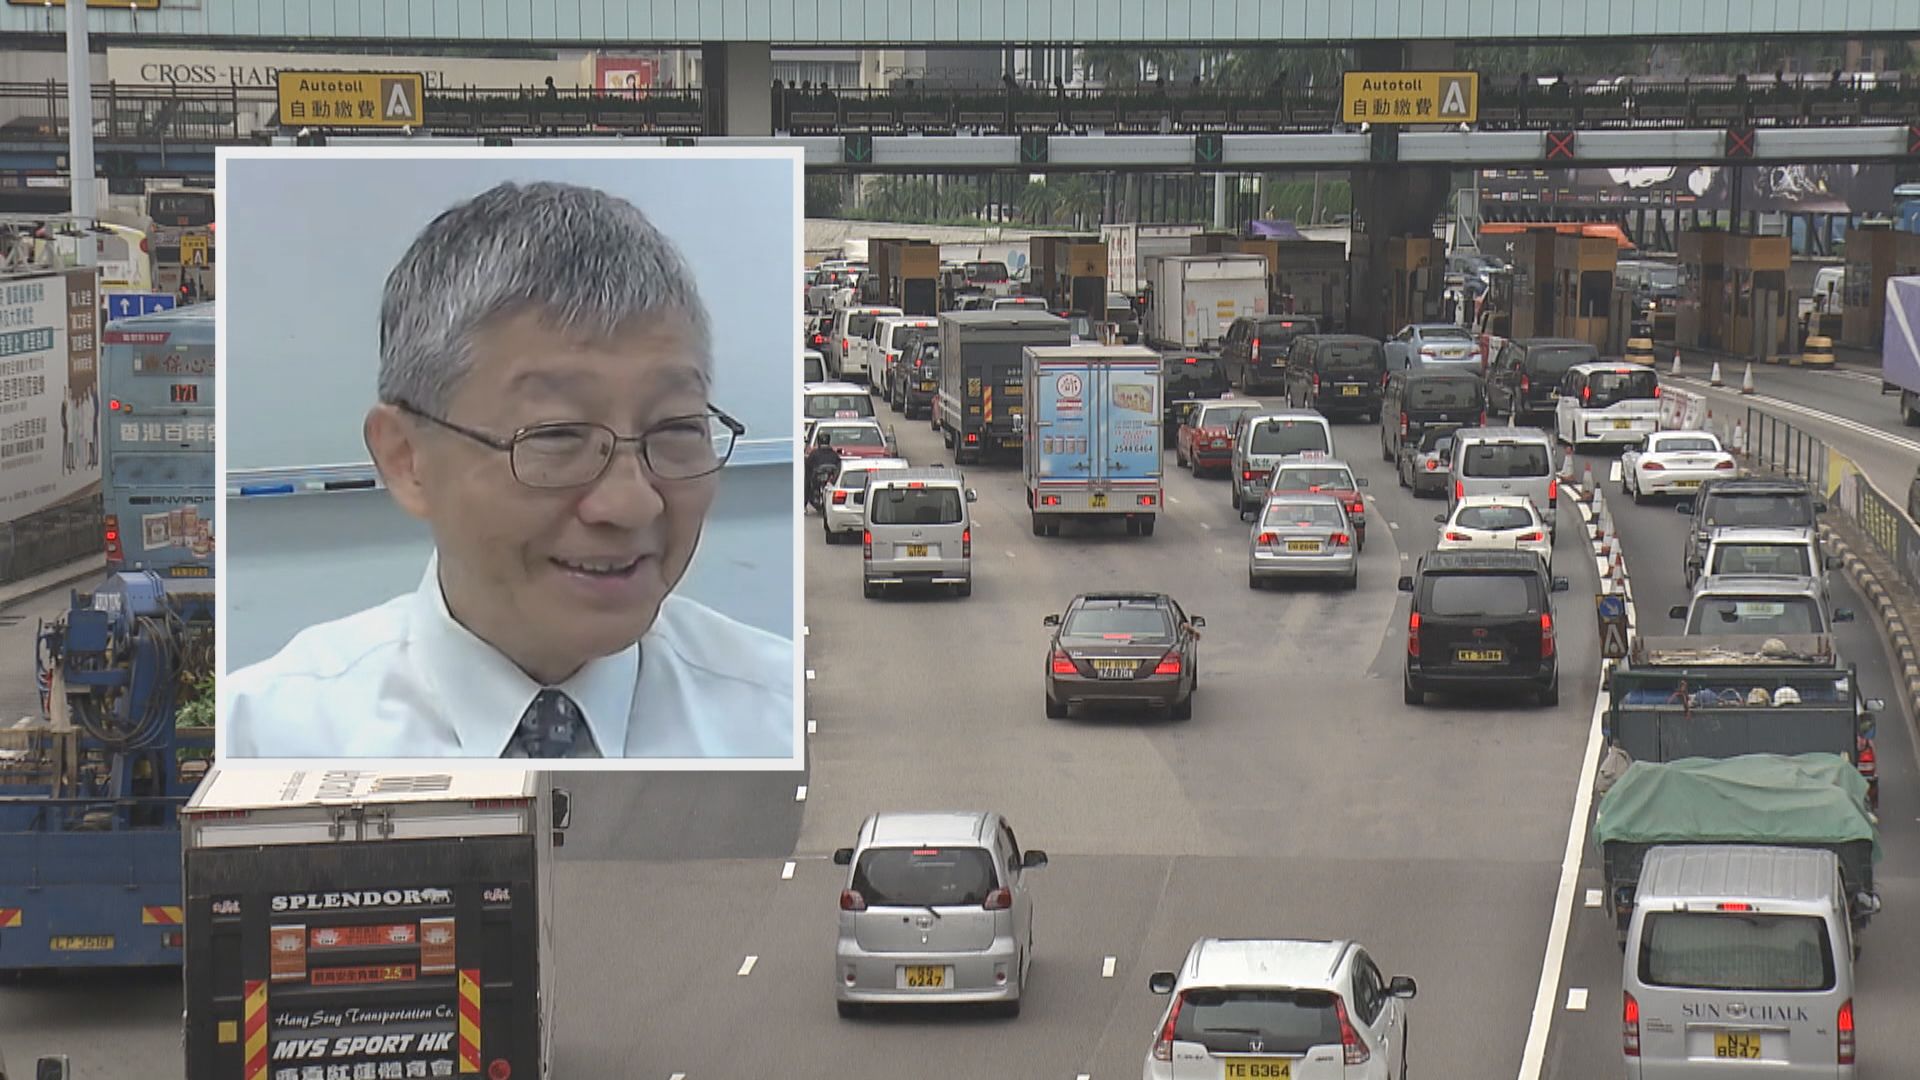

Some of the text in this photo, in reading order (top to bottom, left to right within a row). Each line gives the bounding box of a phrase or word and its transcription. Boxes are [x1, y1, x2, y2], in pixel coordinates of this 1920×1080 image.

[299, 79, 363, 93] Autotoll
[1362, 79, 1422, 91] Autotoll
[290, 100, 375, 119] 自動繳費
[1353, 97, 1433, 116] 自動繳費
[175, 385, 195, 402] 171
[271, 889, 422, 912] SPLENDOR
[275, 1004, 454, 1028] Hang Seng Transportation Co.
[1682, 1002, 1809, 1021] SUN CHALK
[331, 1033, 415, 1057] SPORT
[416, 1031, 455, 1052] HK
[1227, 1063, 1290, 1078] TE 6364
